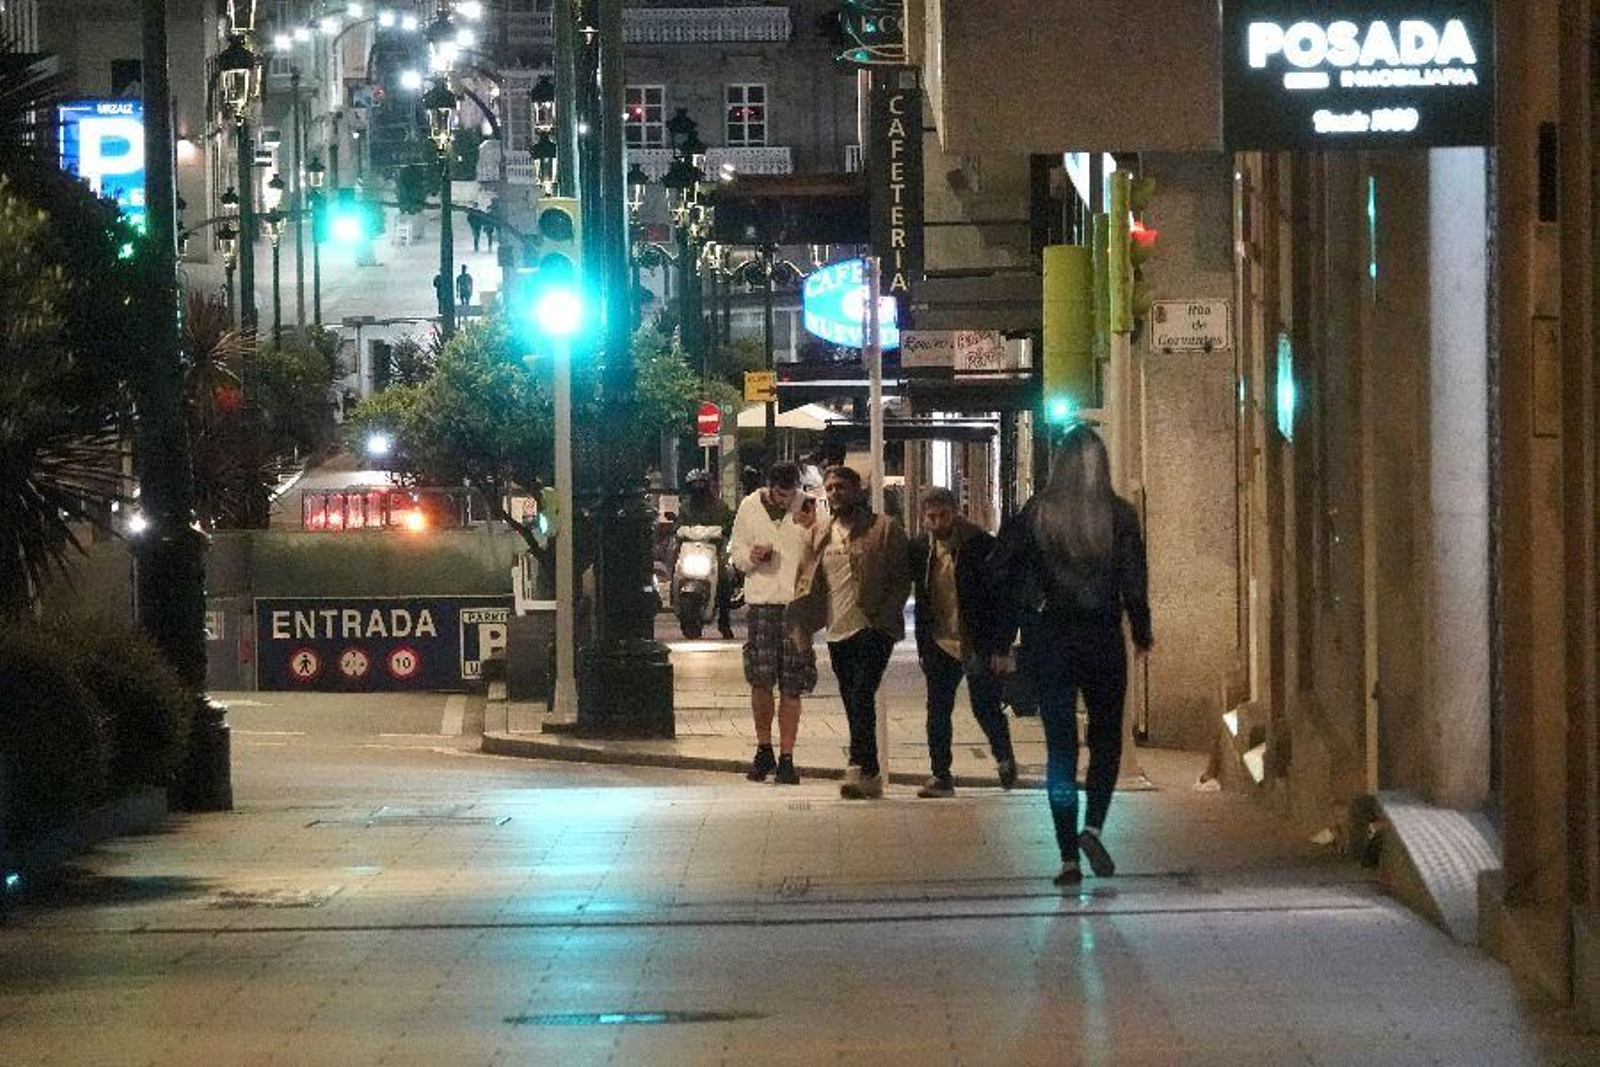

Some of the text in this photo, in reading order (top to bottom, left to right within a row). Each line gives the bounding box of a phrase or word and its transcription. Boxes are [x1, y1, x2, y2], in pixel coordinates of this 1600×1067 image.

[1248, 18, 1478, 68] POSADA
[1340, 68, 1478, 88] INMOBILIARIA
[79, 117, 145, 196] P
[887, 95, 908, 292] CAFETERIA
[1191, 319, 1208, 331] de
[271, 608, 438, 640] ENTRADA
[396, 656, 411, 669] 10
[478, 623, 508, 665] P
